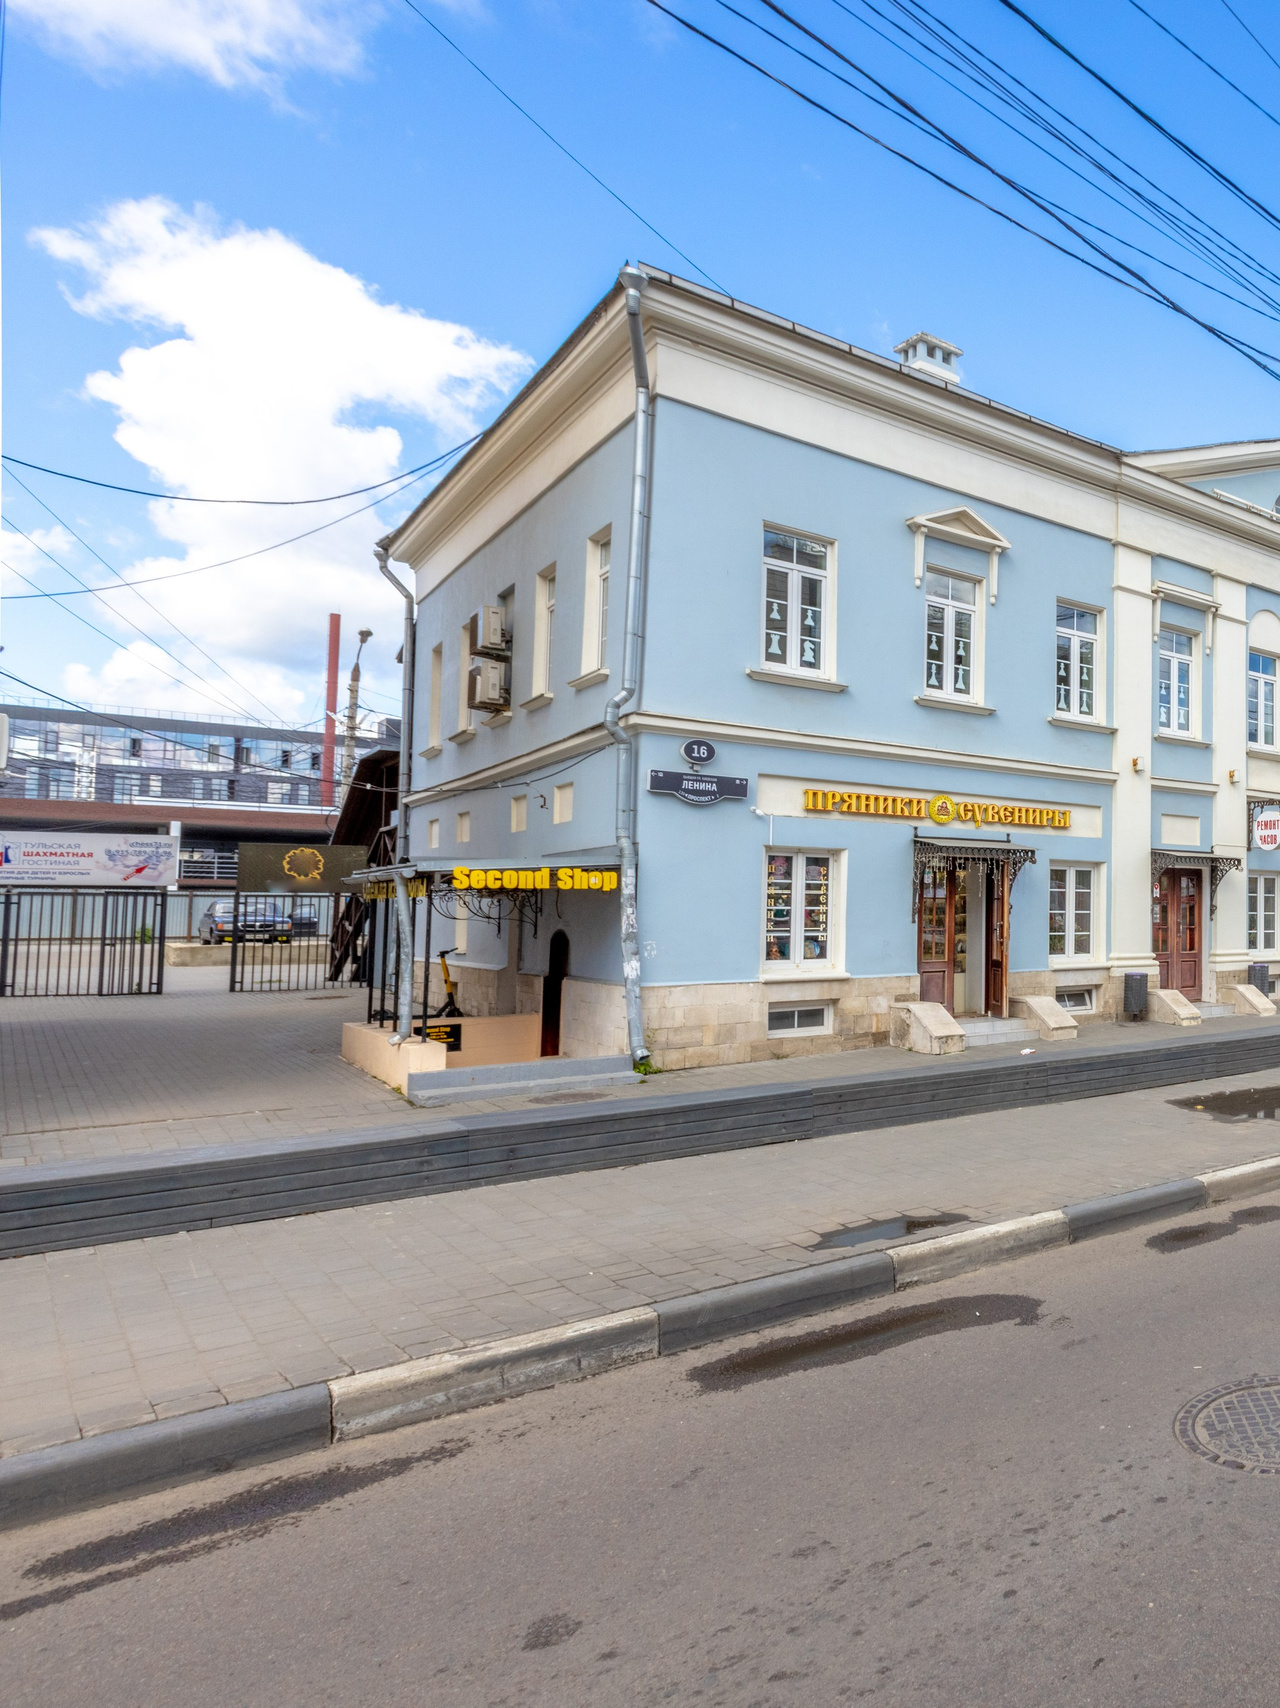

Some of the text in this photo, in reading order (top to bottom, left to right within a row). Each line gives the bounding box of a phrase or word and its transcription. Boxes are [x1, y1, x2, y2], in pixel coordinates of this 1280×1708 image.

[691, 745, 708, 758] 16
[682, 780, 718, 792] ЛЕНИНА
[687, 793, 712, 802] ПРОСПЕКТ
[803, 789, 1072, 828] ПРЯНИКИ СУВЕНИРЫ
[1256, 820, 1280, 831] РЕМОНТ
[1259, 834, 1277, 845] ЧАСОВ
[452, 866, 618, 891] Second Shop
[767, 865, 775, 942] ПРЯНИКИ
[818, 866, 827, 941] СУВЕНИРЫ
